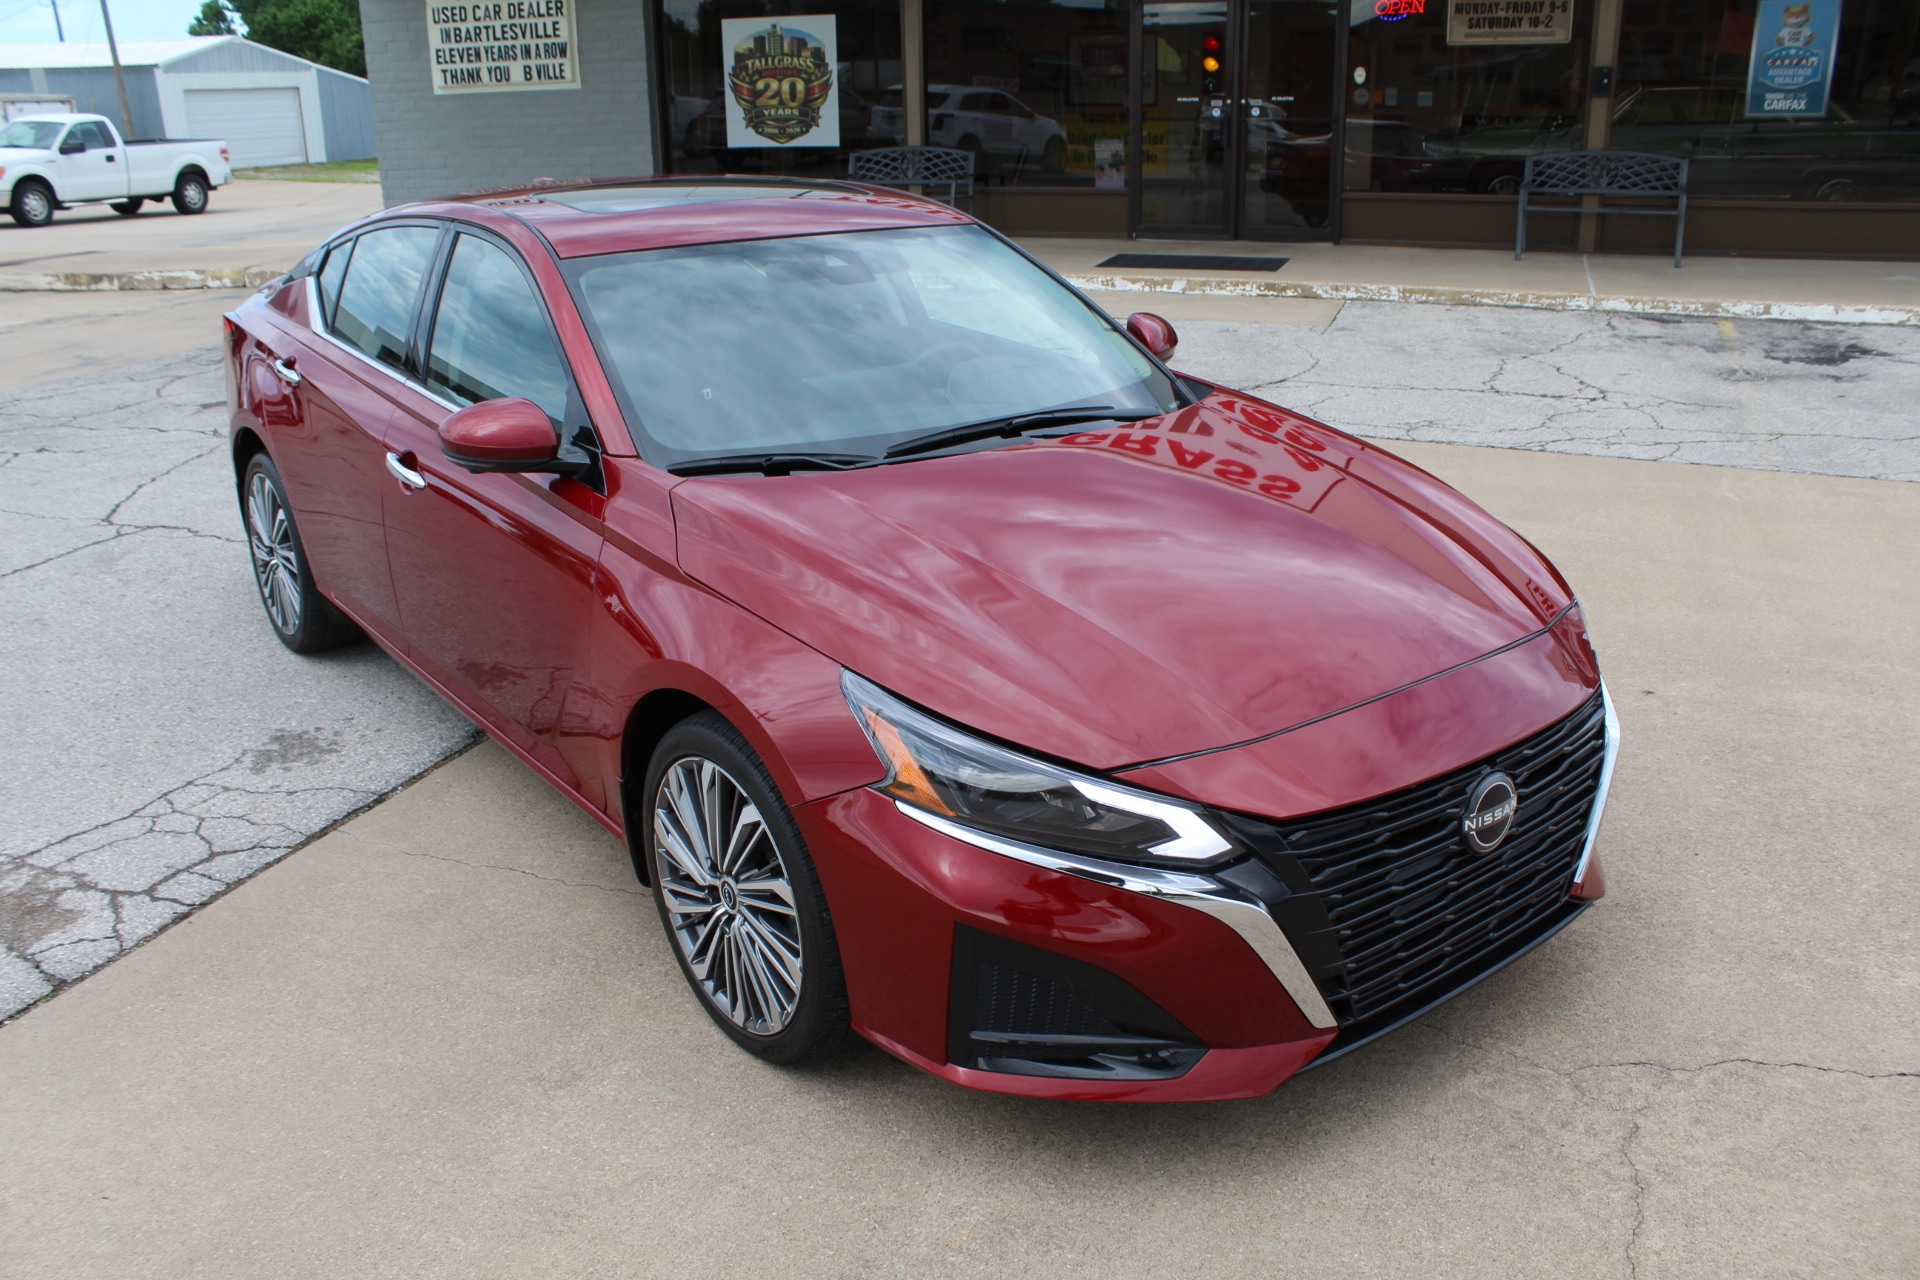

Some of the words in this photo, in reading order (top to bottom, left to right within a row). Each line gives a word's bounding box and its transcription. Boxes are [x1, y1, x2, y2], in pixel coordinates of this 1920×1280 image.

[432, 6, 467, 24] USED
[472, 4, 502, 22] CAR
[507, 0, 564, 19] DEALER
[1375, 0, 1426, 15] OPEN
[1454, 1, 1544, 15] MONDAY-FRIDAY
[1468, 16, 1523, 29] SATURDAY
[1528, 15, 1553, 28] 10-2
[441, 27, 451, 44] IN
[453, 21, 561, 43] BARTLESVILLE
[435, 46, 481, 65] ELEVEN
[483, 44, 517, 62] YEARS
[520, 43, 532, 60] IN
[535, 43, 542, 59] A
[543, 42, 567, 59] ROW
[745, 56, 815, 73] TALLGRASS
[1768, 68, 1812, 76] ADVANTAGE
[441, 67, 483, 85] THANK
[486, 65, 511, 83] YOU
[523, 65, 532, 82] B
[535, 63, 566, 80] VILLE
[1774, 76, 1804, 84] DEALER
[755, 77, 806, 107] 20
[1764, 99, 1808, 110] CARFAX
[763, 108, 800, 117] YEARS
